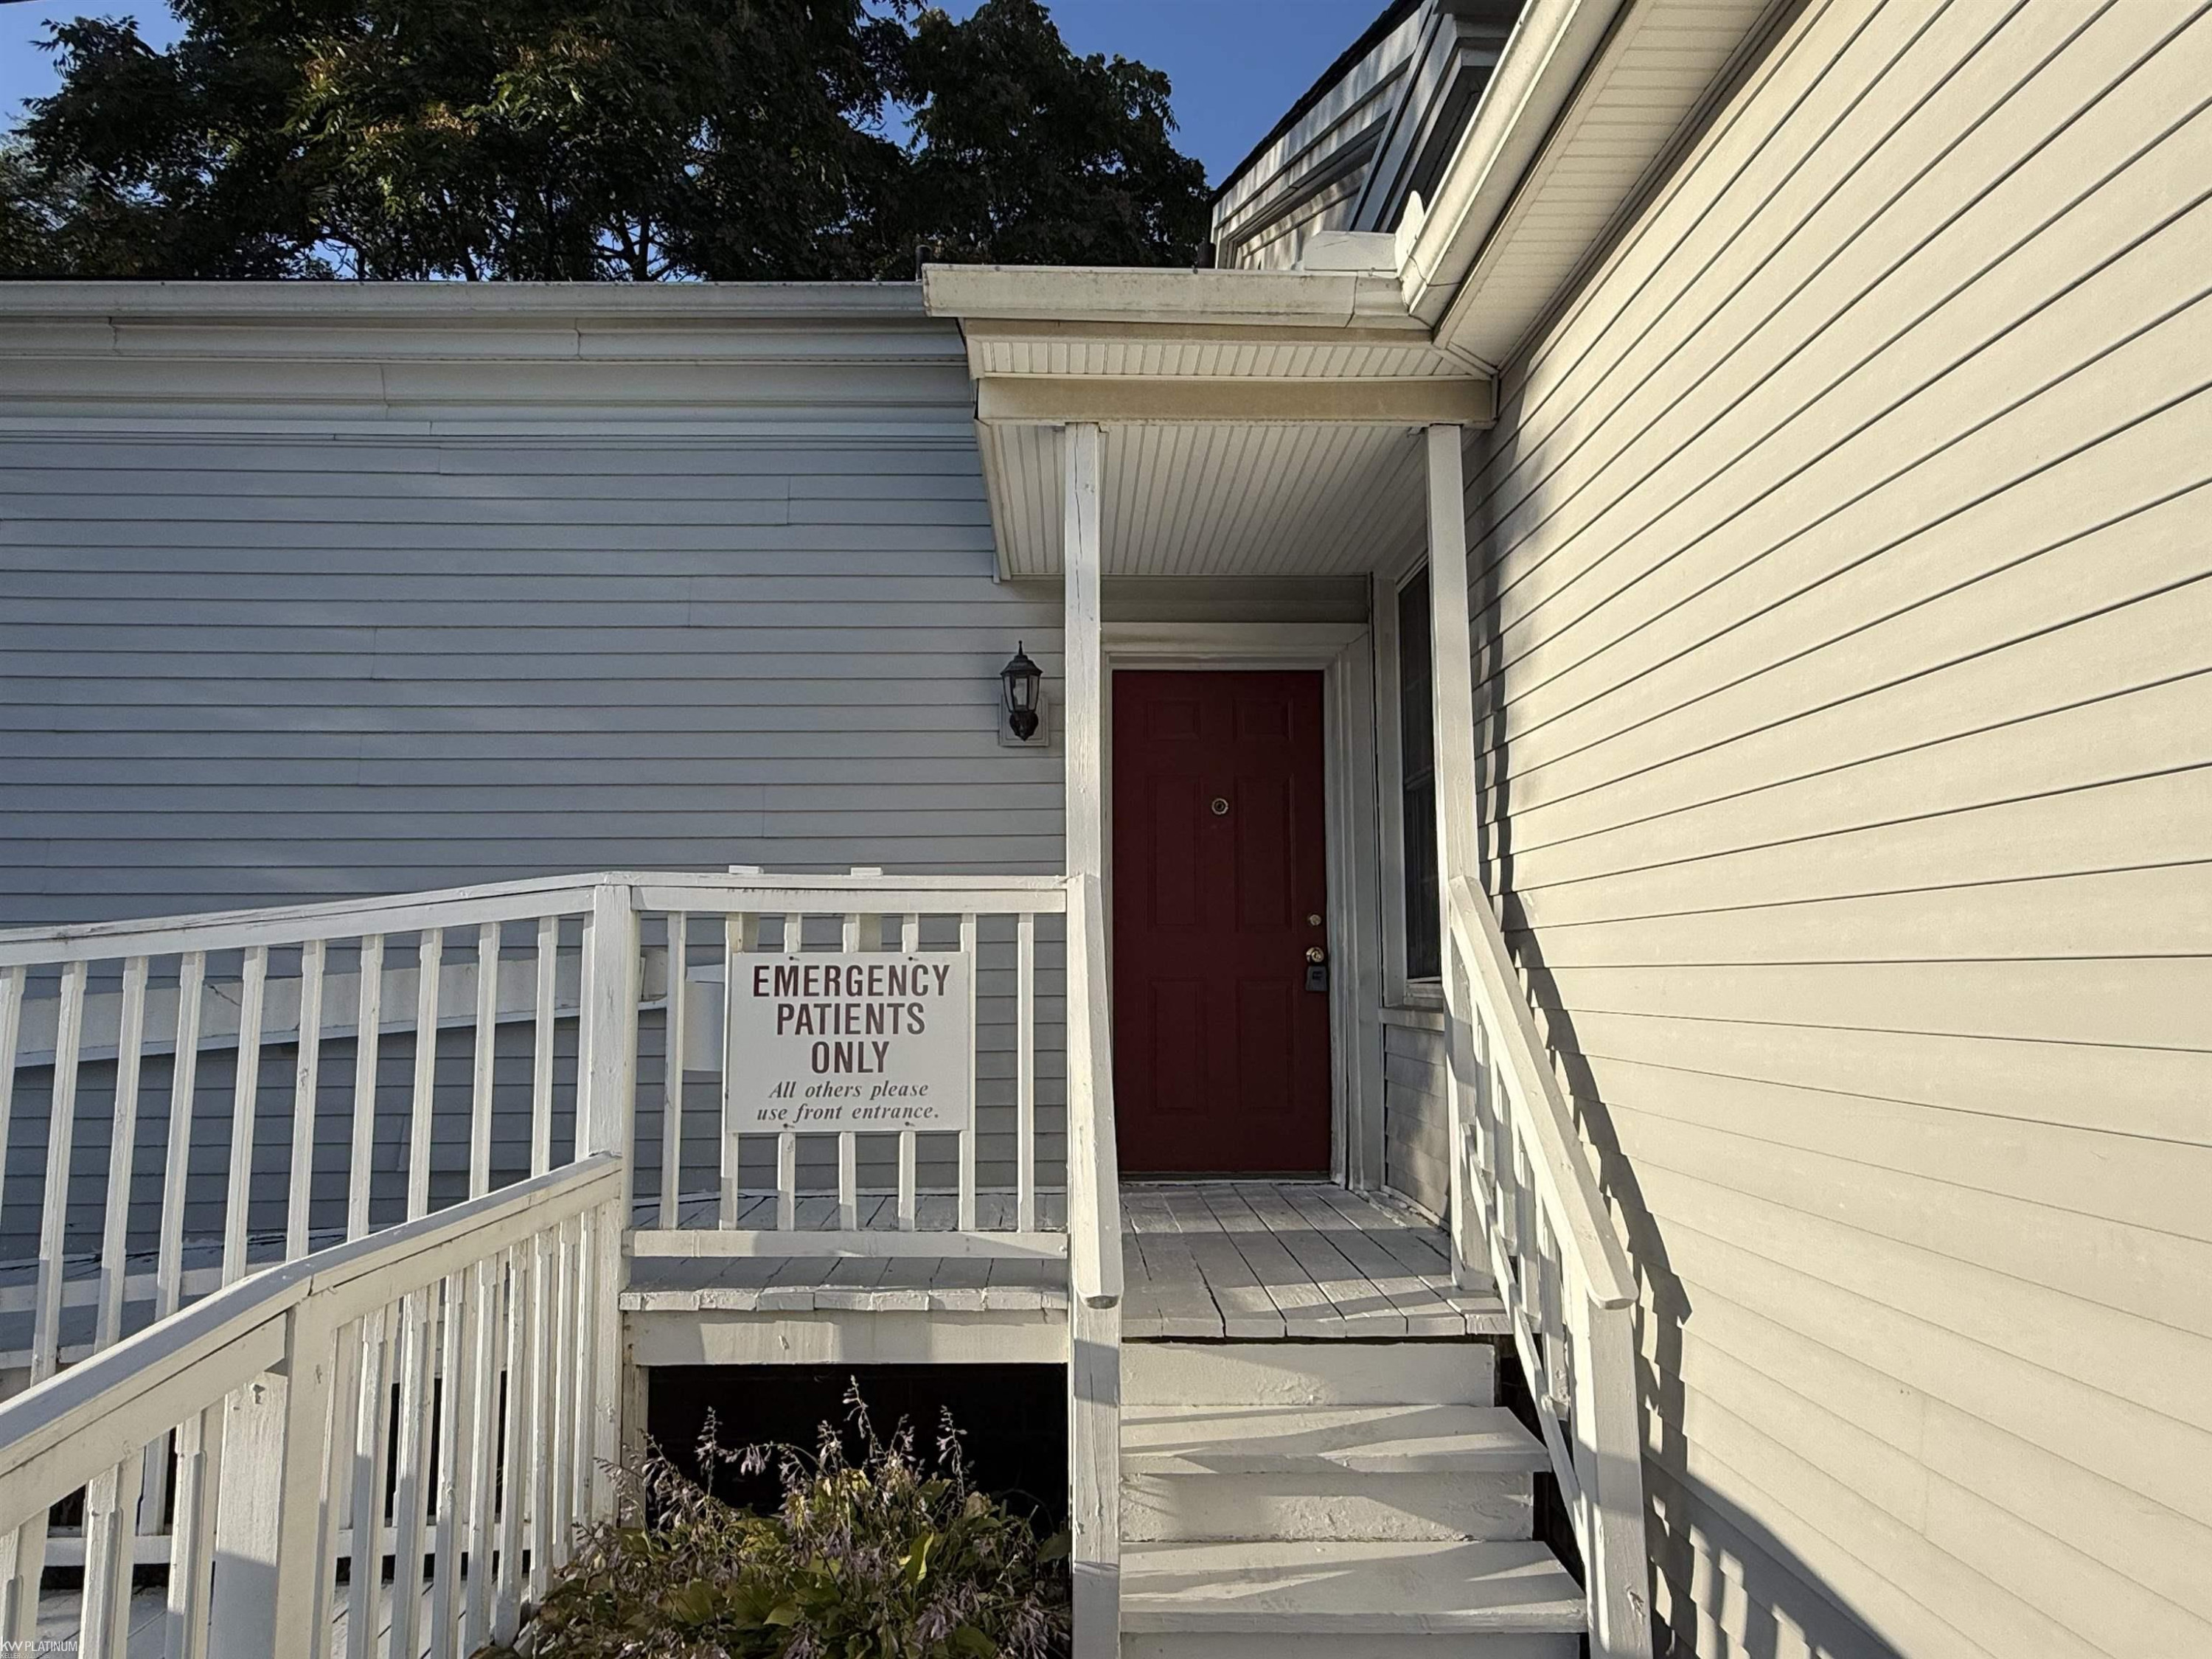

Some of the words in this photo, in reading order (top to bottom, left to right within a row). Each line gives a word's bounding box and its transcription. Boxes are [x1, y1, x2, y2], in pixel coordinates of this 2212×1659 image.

[753, 964, 950, 997] EMERGENCY
[776, 1002, 925, 1035] PATIENTS
[811, 1041, 889, 1074] ONLY
[769, 1082, 796, 1099] All
[804, 1081, 861, 1098] others
[870, 1080, 928, 1100] please
[757, 1107, 788, 1121] use
[793, 1104, 843, 1123] front
[852, 1105, 939, 1119] entrance.
